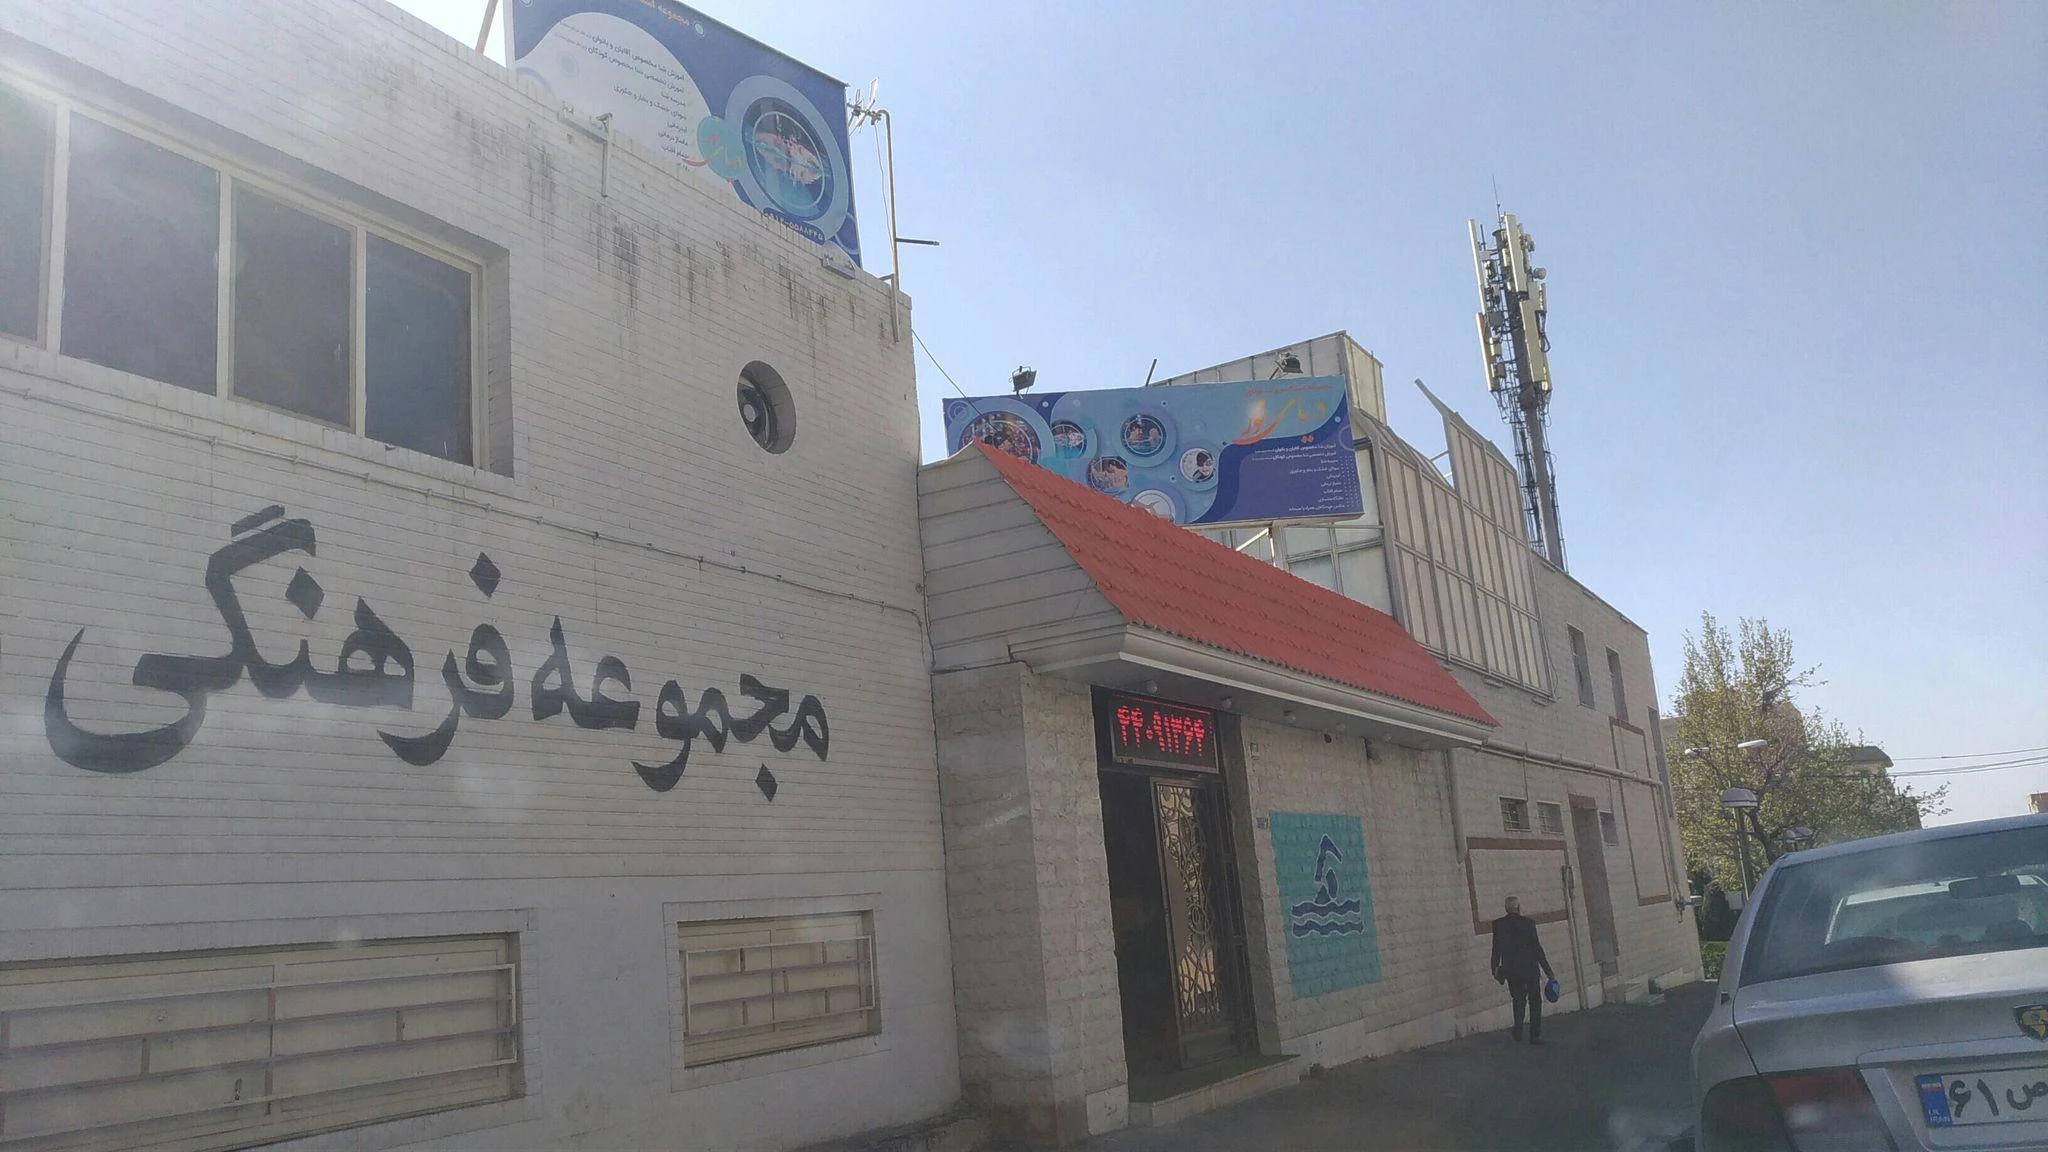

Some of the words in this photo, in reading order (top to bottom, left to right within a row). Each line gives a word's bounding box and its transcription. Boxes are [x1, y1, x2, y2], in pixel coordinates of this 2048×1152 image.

[44, 505, 515, 773] فرهنگی
[532, 615, 829, 802] مجموعه
[1949, 1079, 1999, 1118] ۶۱
